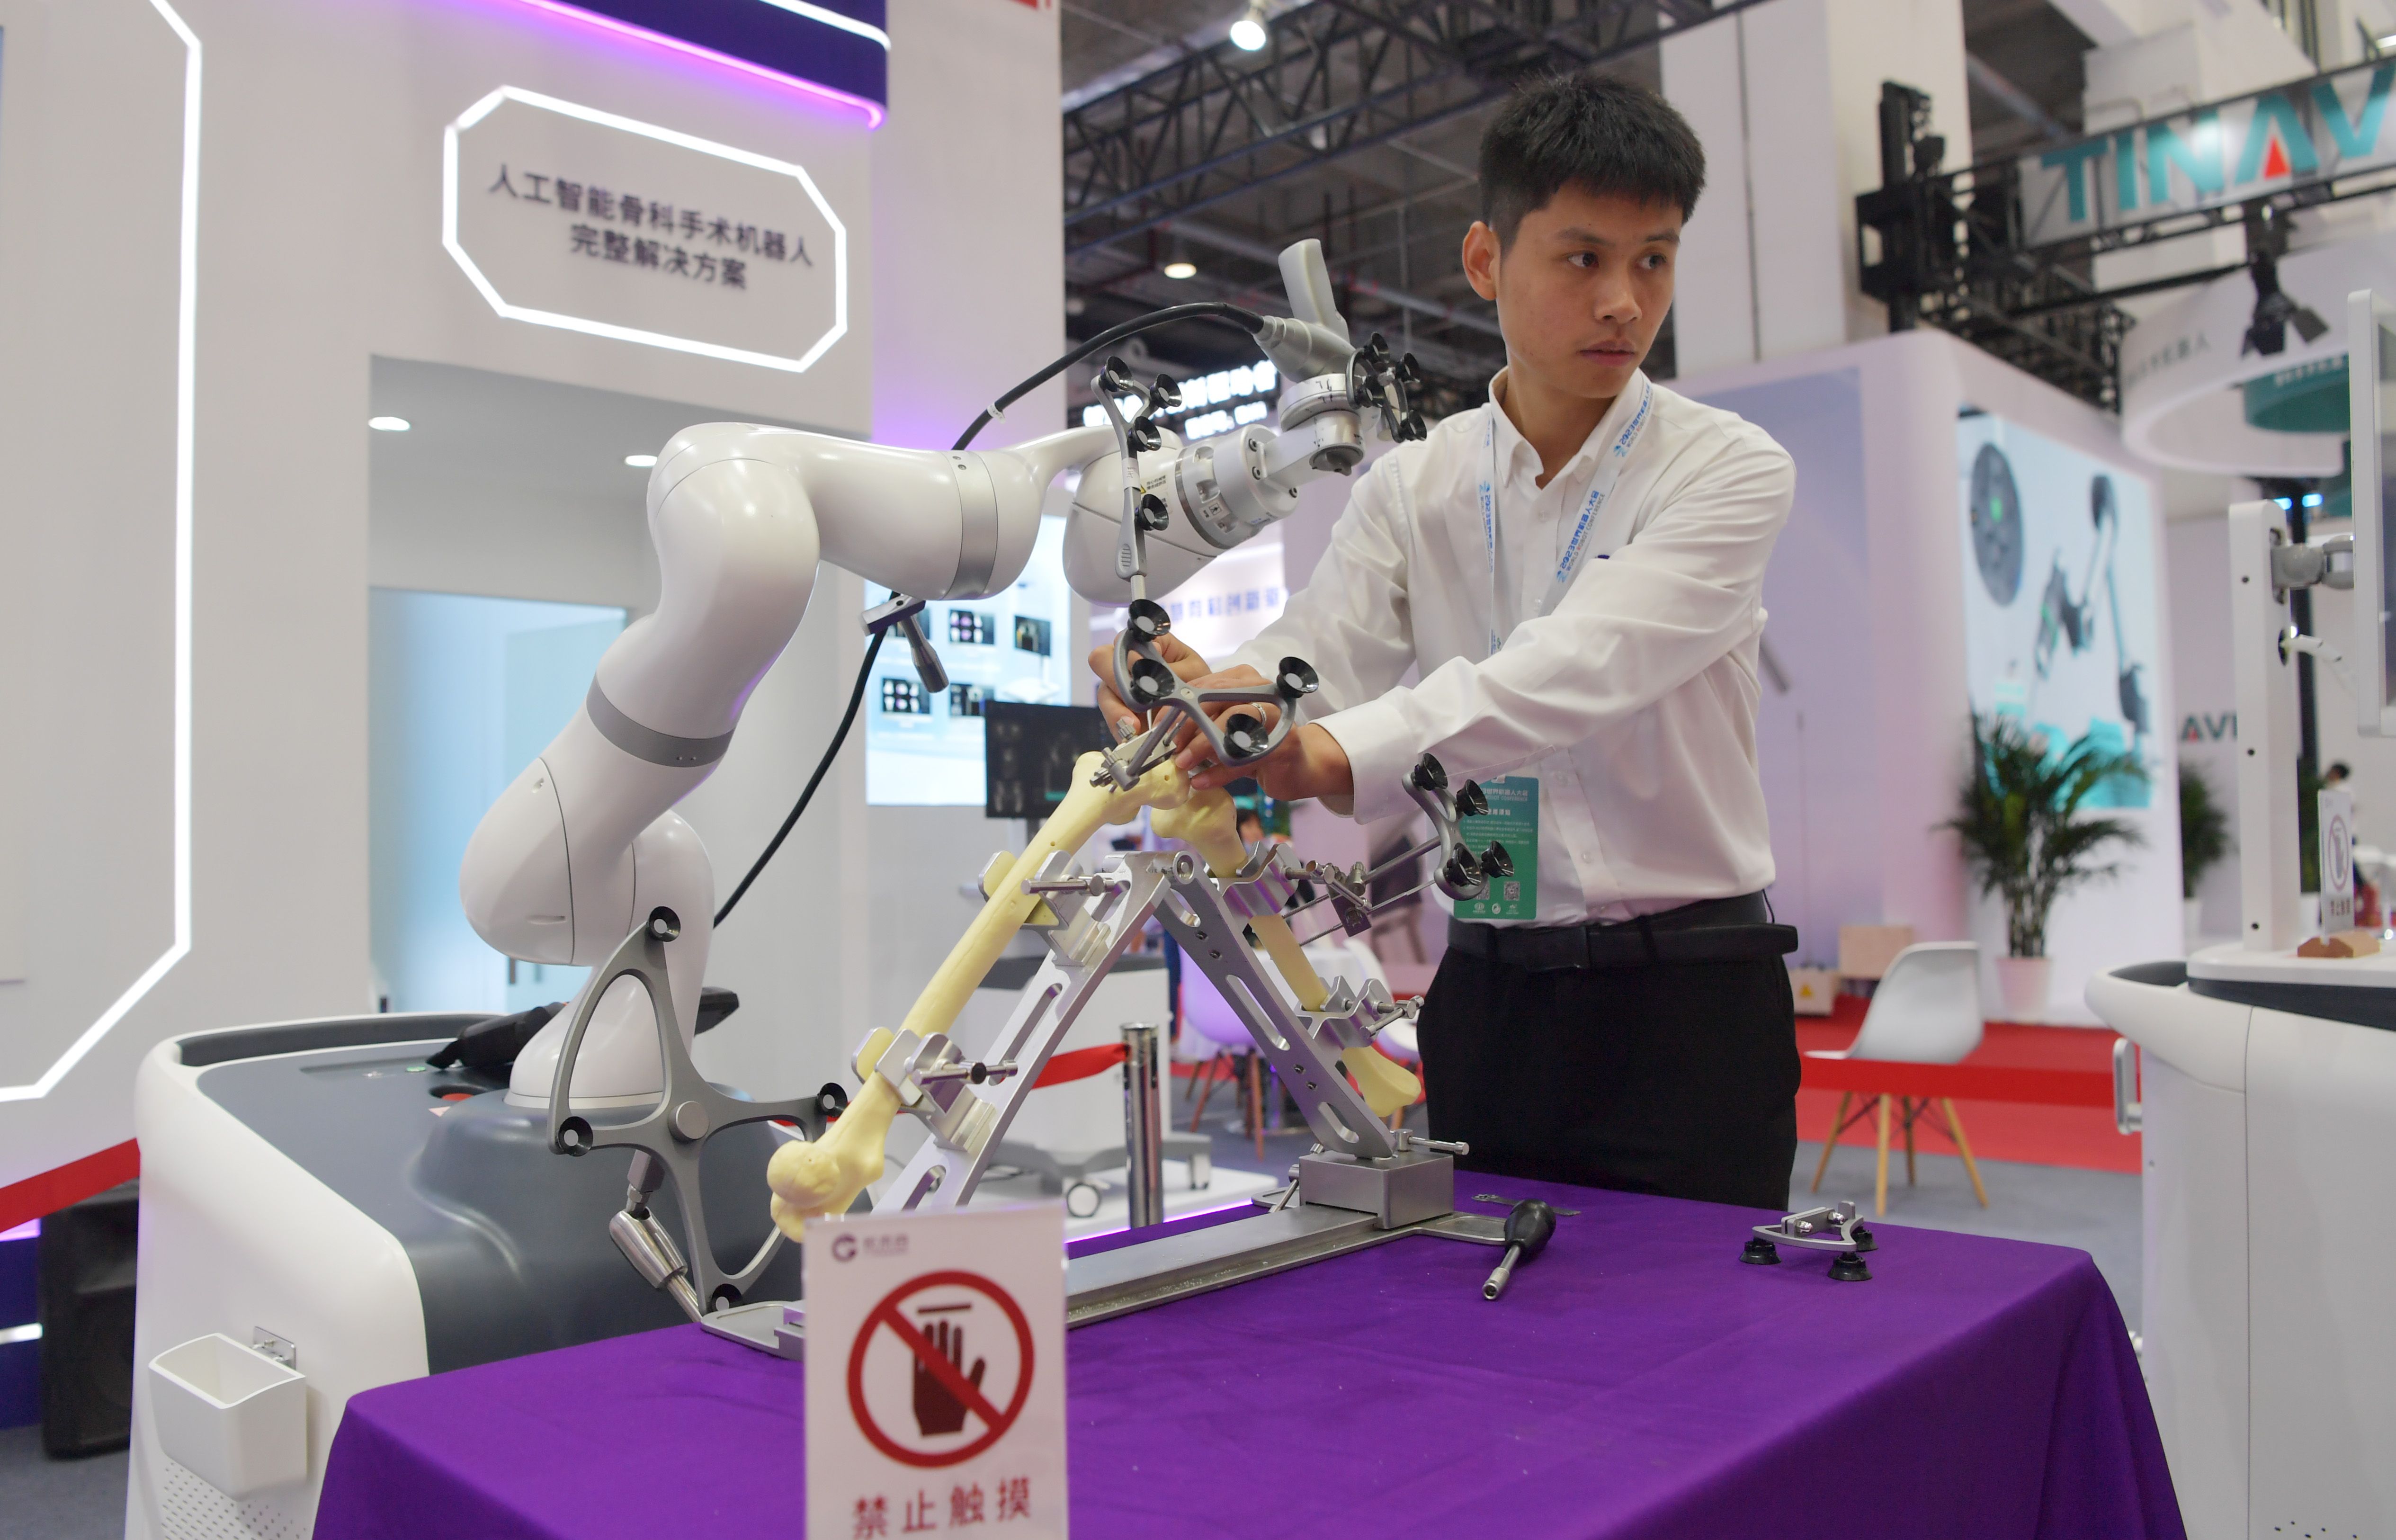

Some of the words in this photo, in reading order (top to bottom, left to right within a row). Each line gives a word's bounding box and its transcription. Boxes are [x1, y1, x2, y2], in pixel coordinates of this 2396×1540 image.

[2041, 62, 2396, 223] TINAV
[488, 163, 813, 268] 人工智能骨科手术机器人
[570, 223, 747, 290] 完整解决方案
[1560, 490, 1600, 570] 2023世界机器人大会
[1565, 551, 1579, 572] WORLD
[1576, 531, 1589, 551] ROBOT
[1586, 492, 1606, 531] CONFERENCE
[852, 1475, 1031, 1540] 禁止触摸
